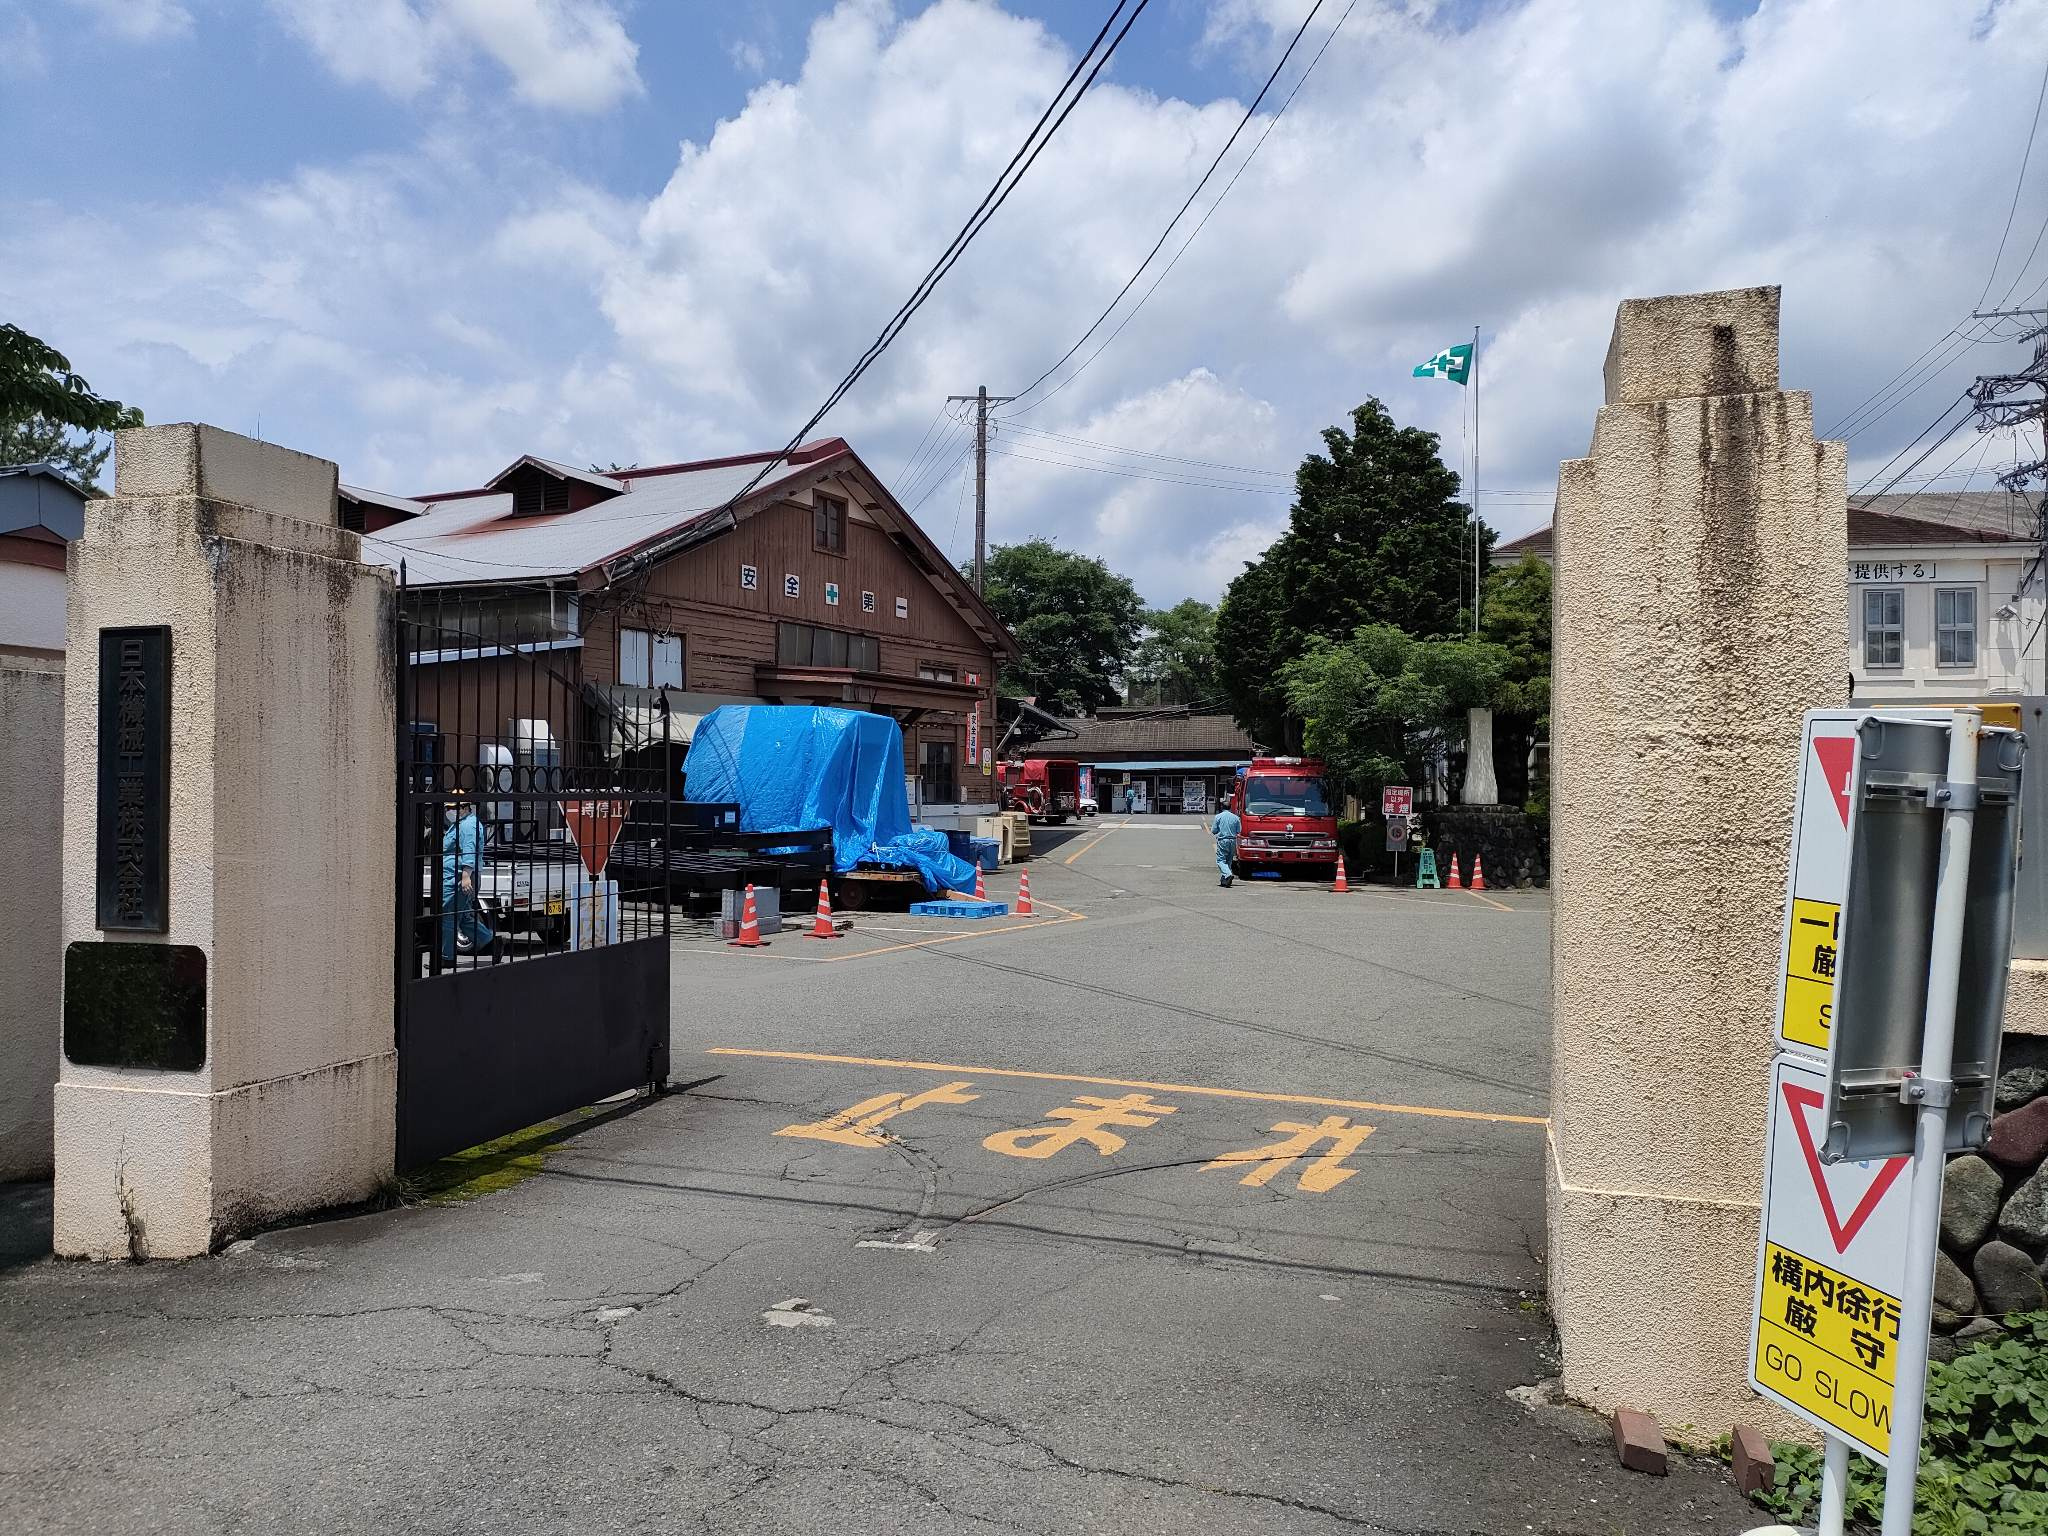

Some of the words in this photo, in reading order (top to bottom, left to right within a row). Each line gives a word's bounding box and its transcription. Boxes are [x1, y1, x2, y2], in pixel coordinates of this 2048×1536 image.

[1849, 562, 1936, 580] 提供する」
[116, 639, 146, 921] 日本機械工業株式会社
[566, 801, 623, 819] 一時停止
[1385, 803, 1409, 813] 禁煙
[1771, 1250, 1902, 1341] 構内徐行
[1765, 1343, 1803, 1382] GO
